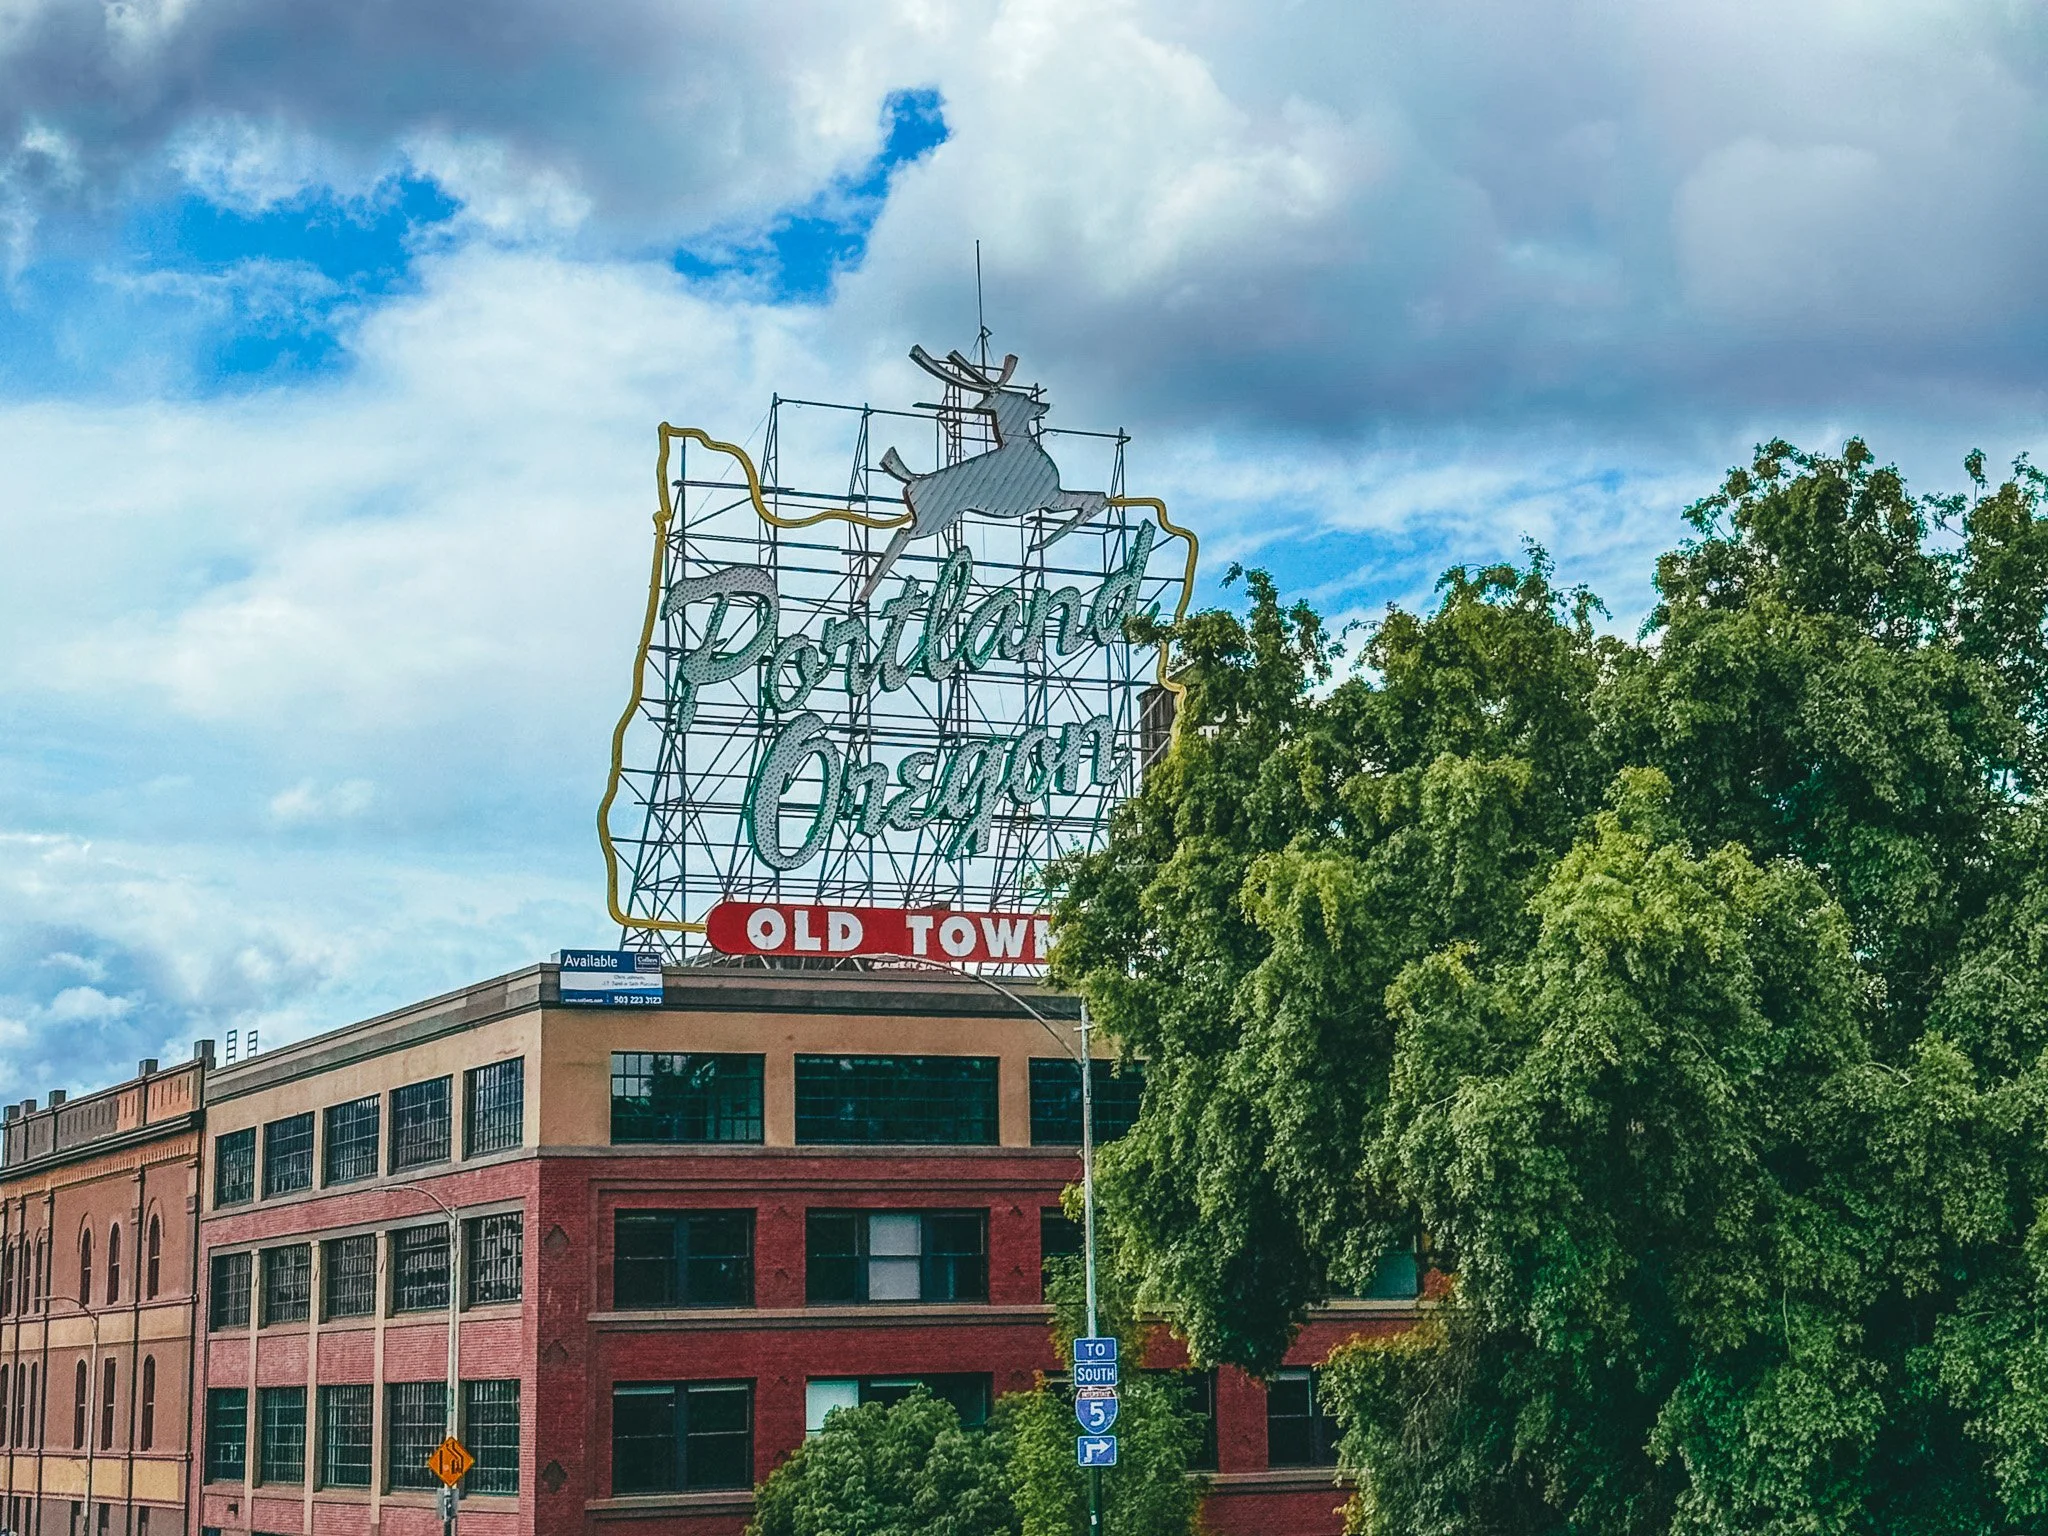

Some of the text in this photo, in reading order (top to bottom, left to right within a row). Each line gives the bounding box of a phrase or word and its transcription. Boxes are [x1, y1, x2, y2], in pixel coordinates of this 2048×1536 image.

[660, 518, 1160, 733] Portland
[746, 711, 1133, 871] Oregon
[747, 907, 863, 952] OLD
[564, 954, 618, 968] Available
[613, 995, 662, 1004] 503 223 3123
[1085, 1343, 1106, 1357] TO
[1077, 1367, 1115, 1382] SOUTH
[1090, 1401, 1106, 1427] 5
